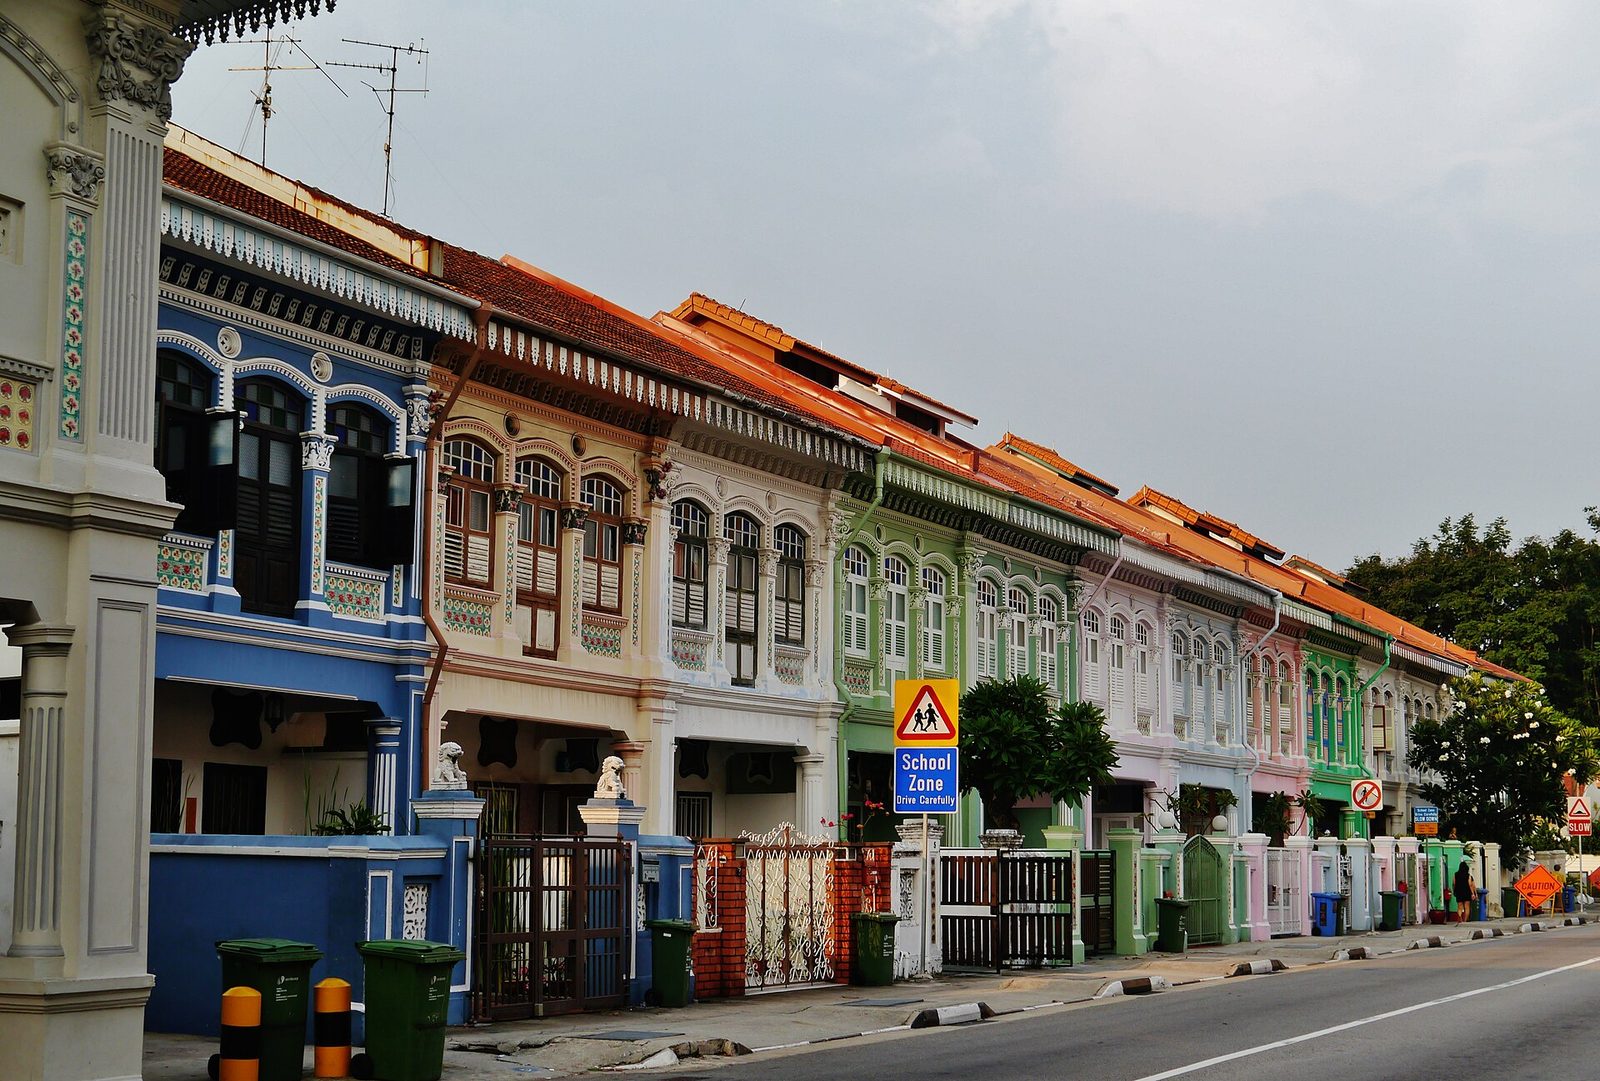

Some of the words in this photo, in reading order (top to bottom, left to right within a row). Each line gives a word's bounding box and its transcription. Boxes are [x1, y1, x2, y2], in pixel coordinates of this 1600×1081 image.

[902, 753, 951, 771] School
[908, 774, 944, 792] Zone
[896, 795, 917, 805] Drive
[919, 795, 955, 807] Carefully
[1569, 822, 1590, 832] SLOW
[1521, 882, 1555, 891] CAUTION
